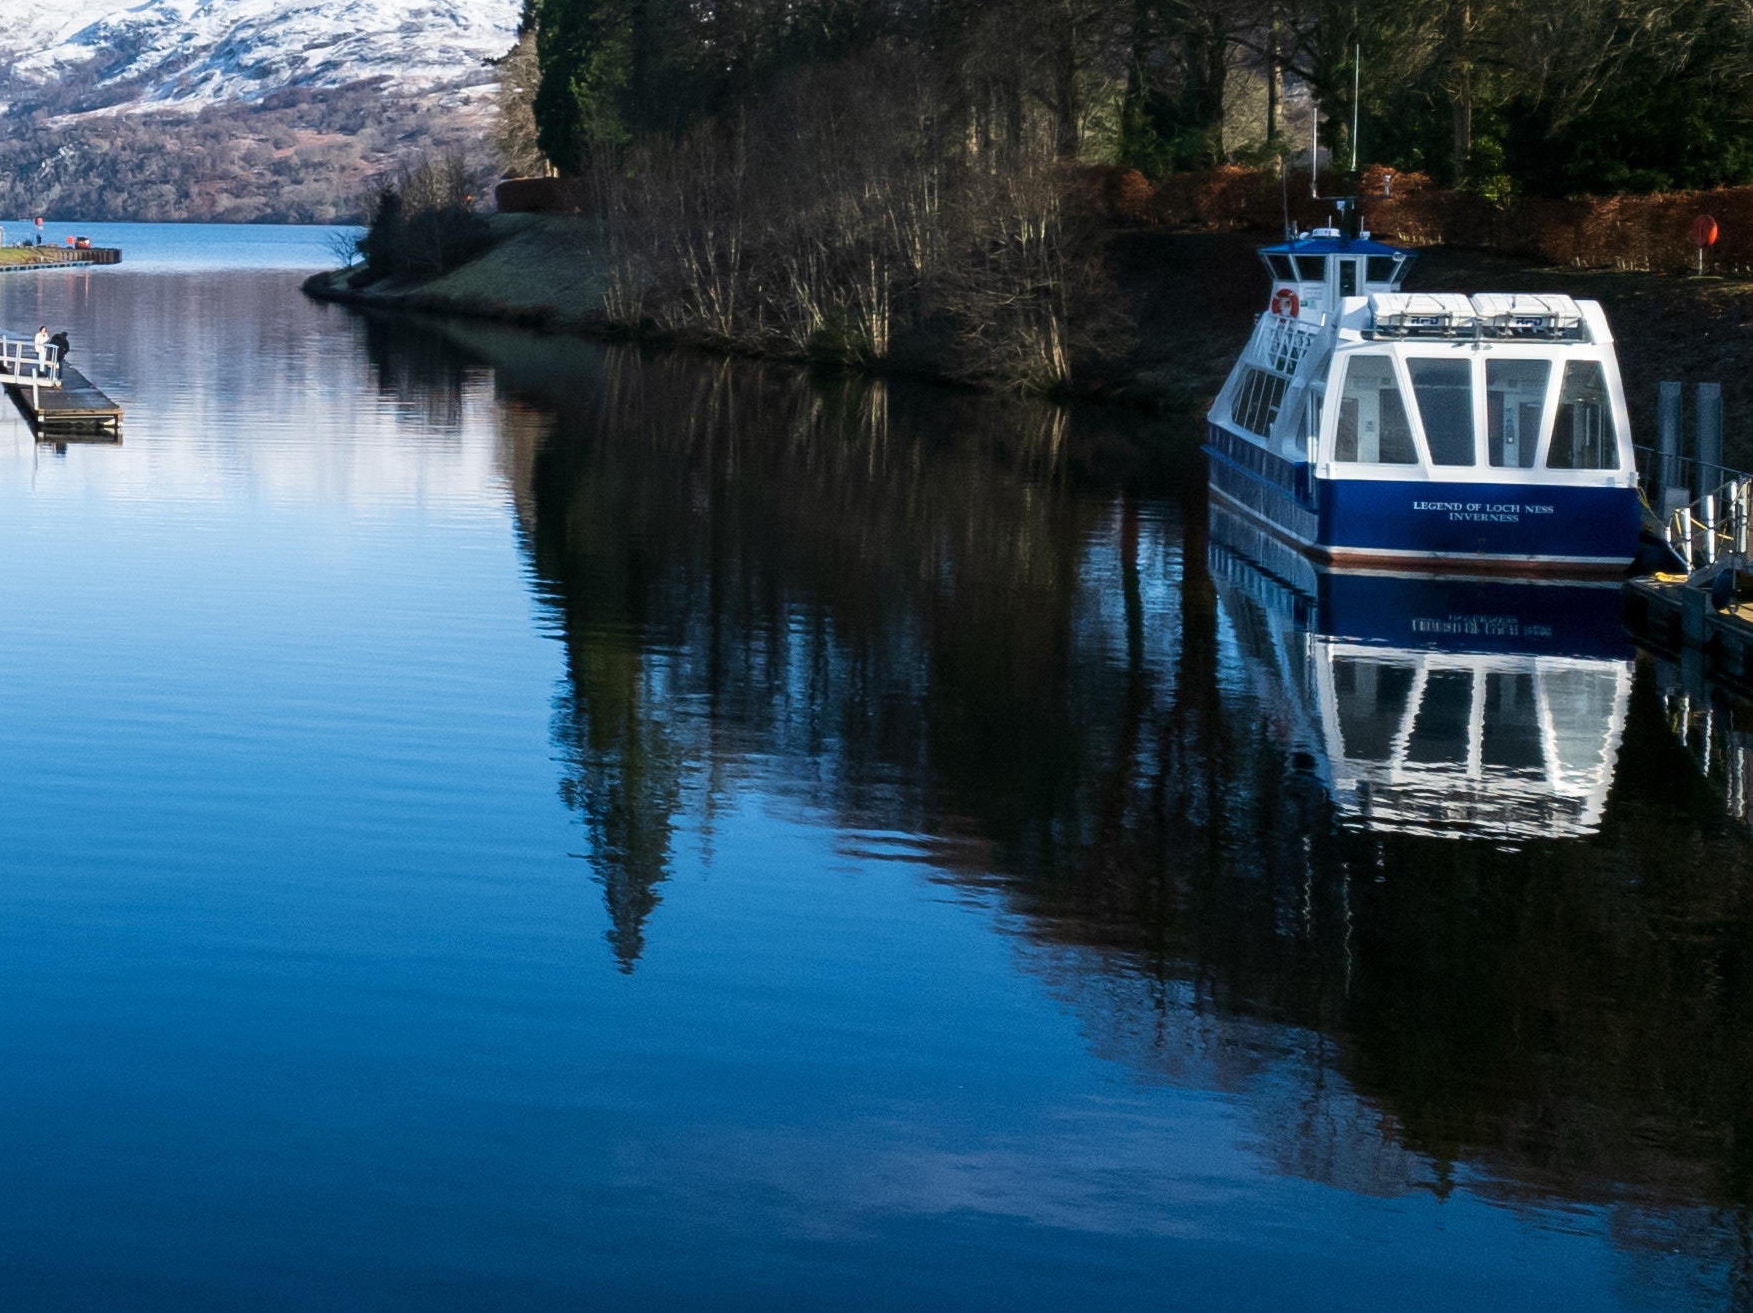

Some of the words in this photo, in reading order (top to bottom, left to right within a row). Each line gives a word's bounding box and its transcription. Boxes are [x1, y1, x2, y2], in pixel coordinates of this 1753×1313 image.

[1413, 501, 1462, 511] LEGEND
[1466, 503, 1482, 512] OF
[1486, 504, 1520, 513] LOCH
[1525, 505, 1554, 514] NESS
[1449, 512, 1519, 522] INVERNESS
